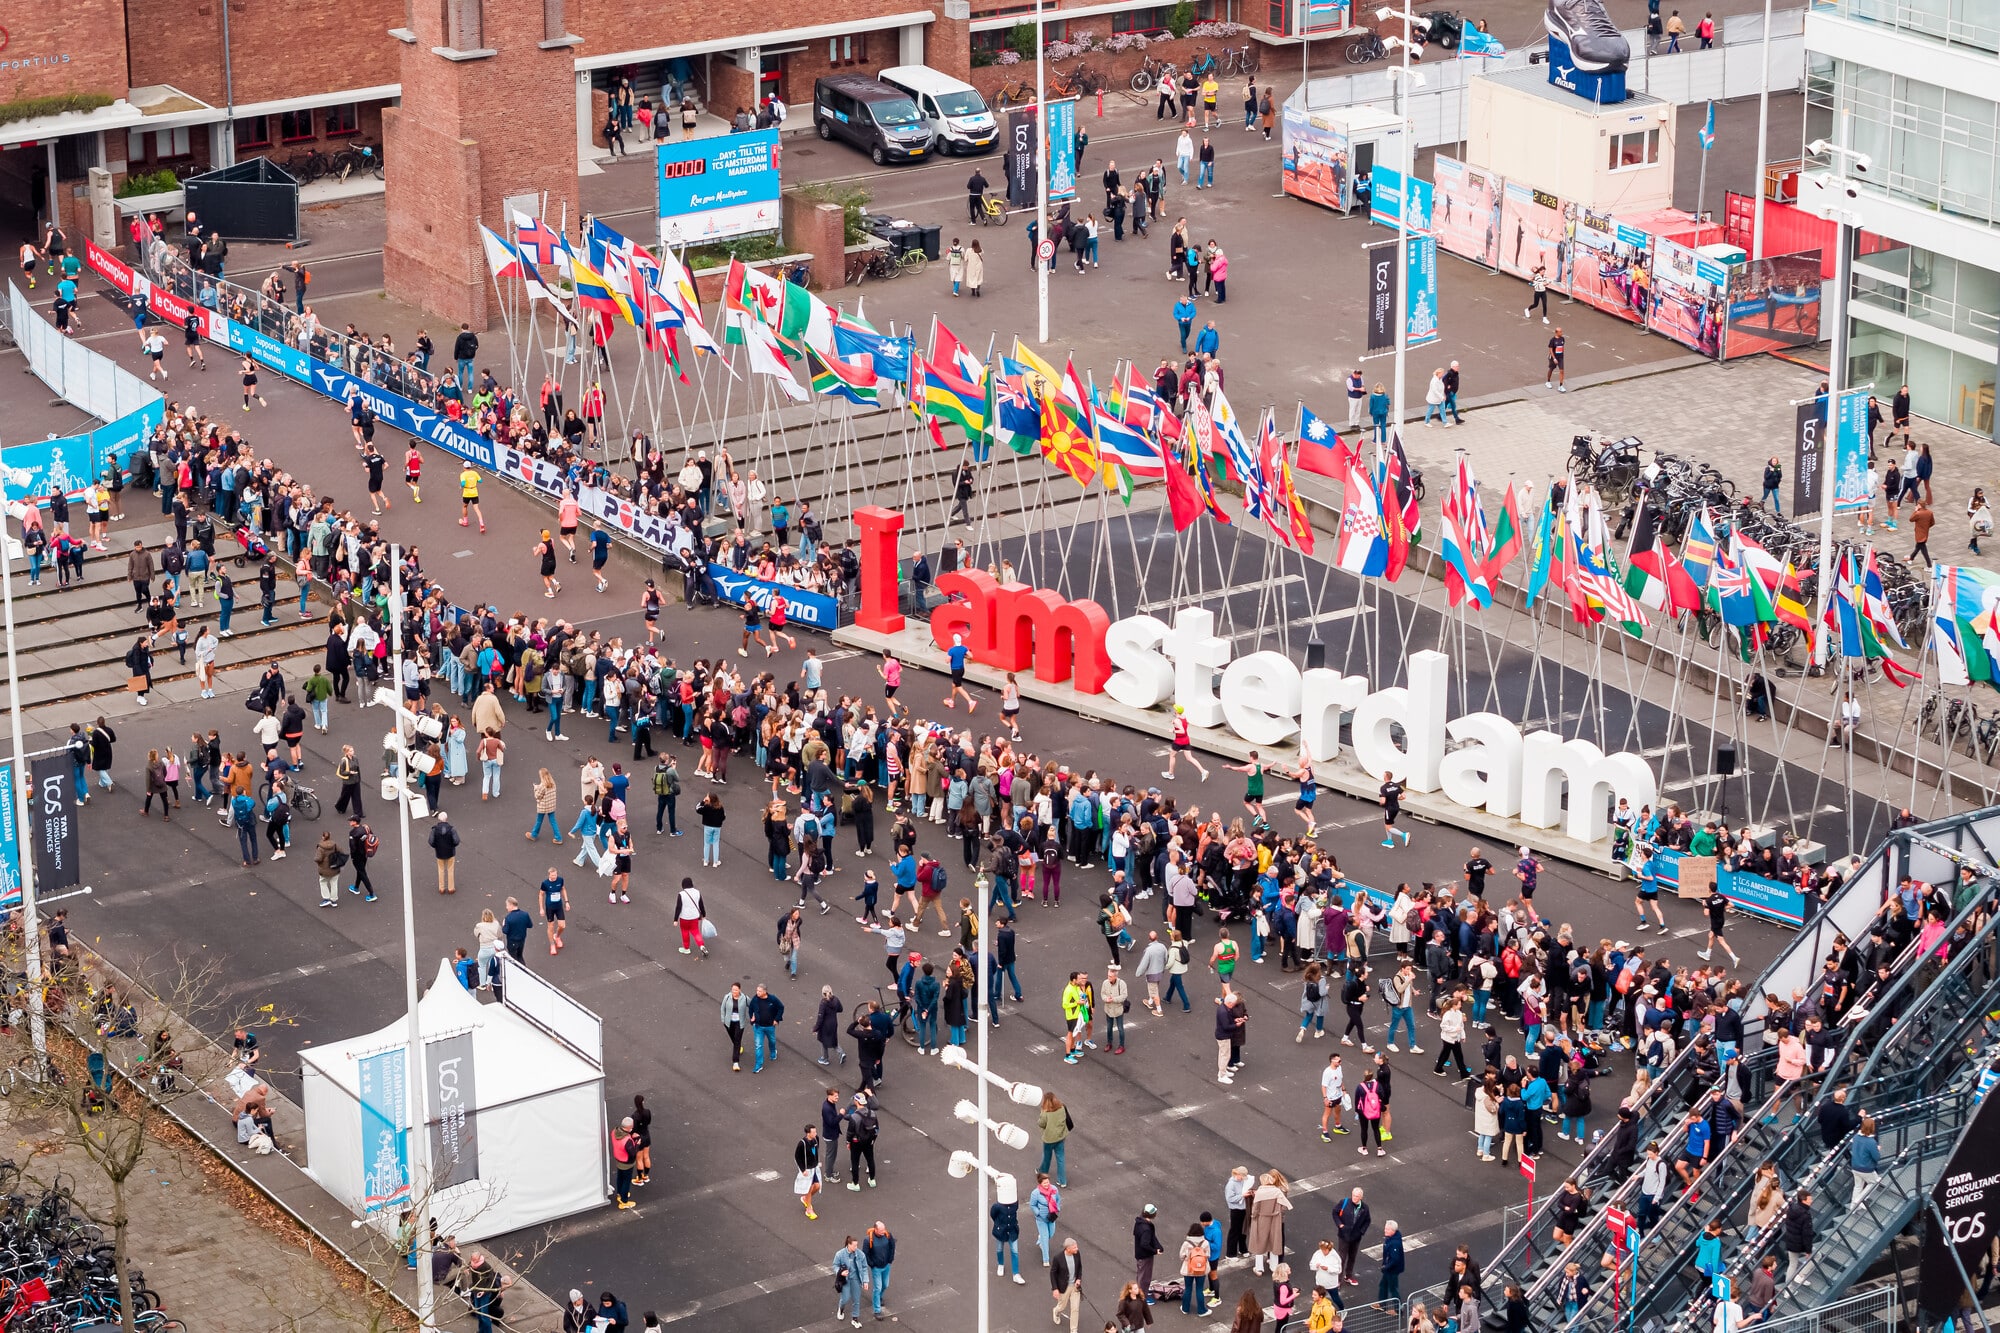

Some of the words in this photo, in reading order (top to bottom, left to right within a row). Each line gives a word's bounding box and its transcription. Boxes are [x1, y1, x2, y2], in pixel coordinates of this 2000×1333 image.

[0, 54, 70, 70] FORTIUS
[750, 46, 758, 59] B
[580, 70, 589, 83] B
[754, 146, 767, 154] THE
[665, 159, 704, 178] 0000
[712, 162, 724, 170] TCS
[724, 154, 767, 168] AMSTERDAM
[728, 164, 768, 176] MARATHON
[1042, 245, 1050, 254] 30
[89, 247, 96, 260] le
[95, 252, 128, 286] Champion
[155, 292, 162, 307] le
[164, 298, 204, 328] Chamn
[231, 334, 244, 346] KLM
[255, 335, 282, 355] Supporter
[252, 346, 262, 358] van
[263, 349, 286, 370] Running
[296, 365, 310, 377] KLM
[604, 496, 676, 550] POLAR
[853, 504, 906, 635] I
[1, 788, 13, 842] AMSTERDAM
[46, 818, 54, 854] SERVICES
[60, 815, 68, 839] TATA
[53, 817, 62, 870] CONSULTANCY
[1738, 886, 1768, 901] MARATHON
[1750, 882, 1788, 898] AMSTERDAM
[382, 1056, 392, 1108] MARATHON
[394, 1074, 404, 1134] AMSTERDAM
[458, 1102, 466, 1129] TATA
[440, 1108, 450, 1146] SERVICES
[450, 1104, 460, 1164] CONSULTANCY
[1946, 1172, 1973, 1187] TATA
[1945, 1190, 1984, 1209] SERVICES
